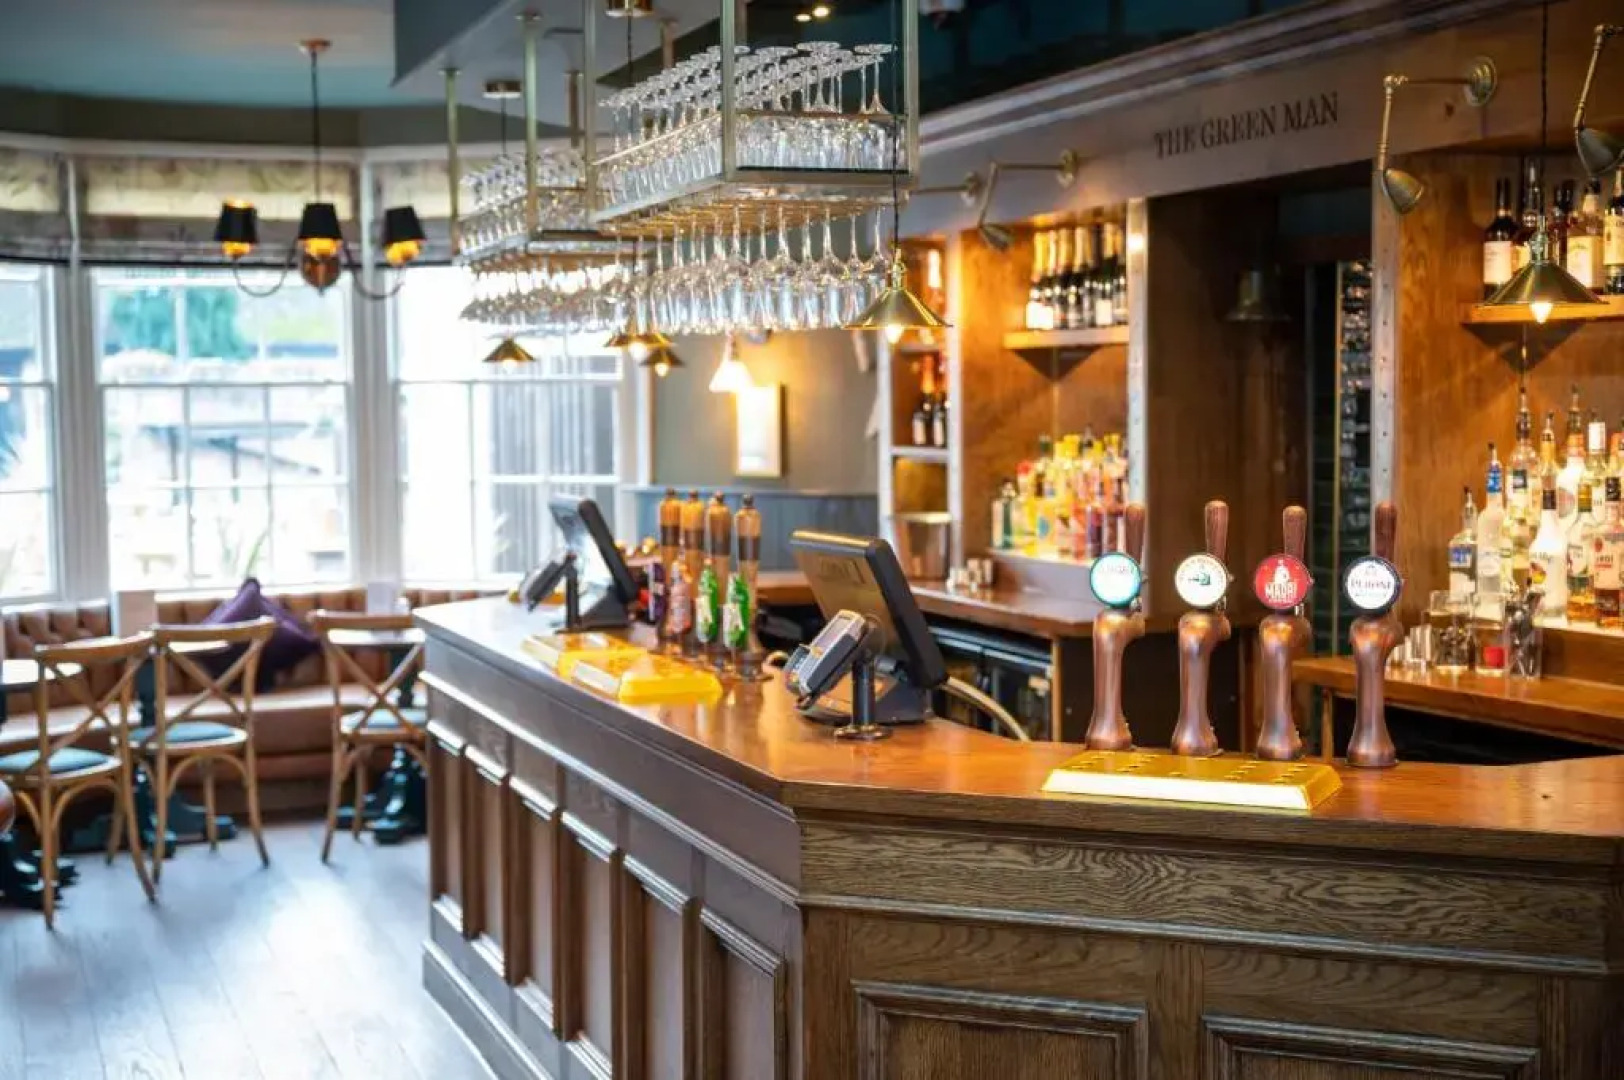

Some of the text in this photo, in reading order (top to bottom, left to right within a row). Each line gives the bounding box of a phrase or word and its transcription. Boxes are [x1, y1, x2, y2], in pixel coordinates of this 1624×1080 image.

[1154, 91, 1338, 159] THE GREEN MAN
